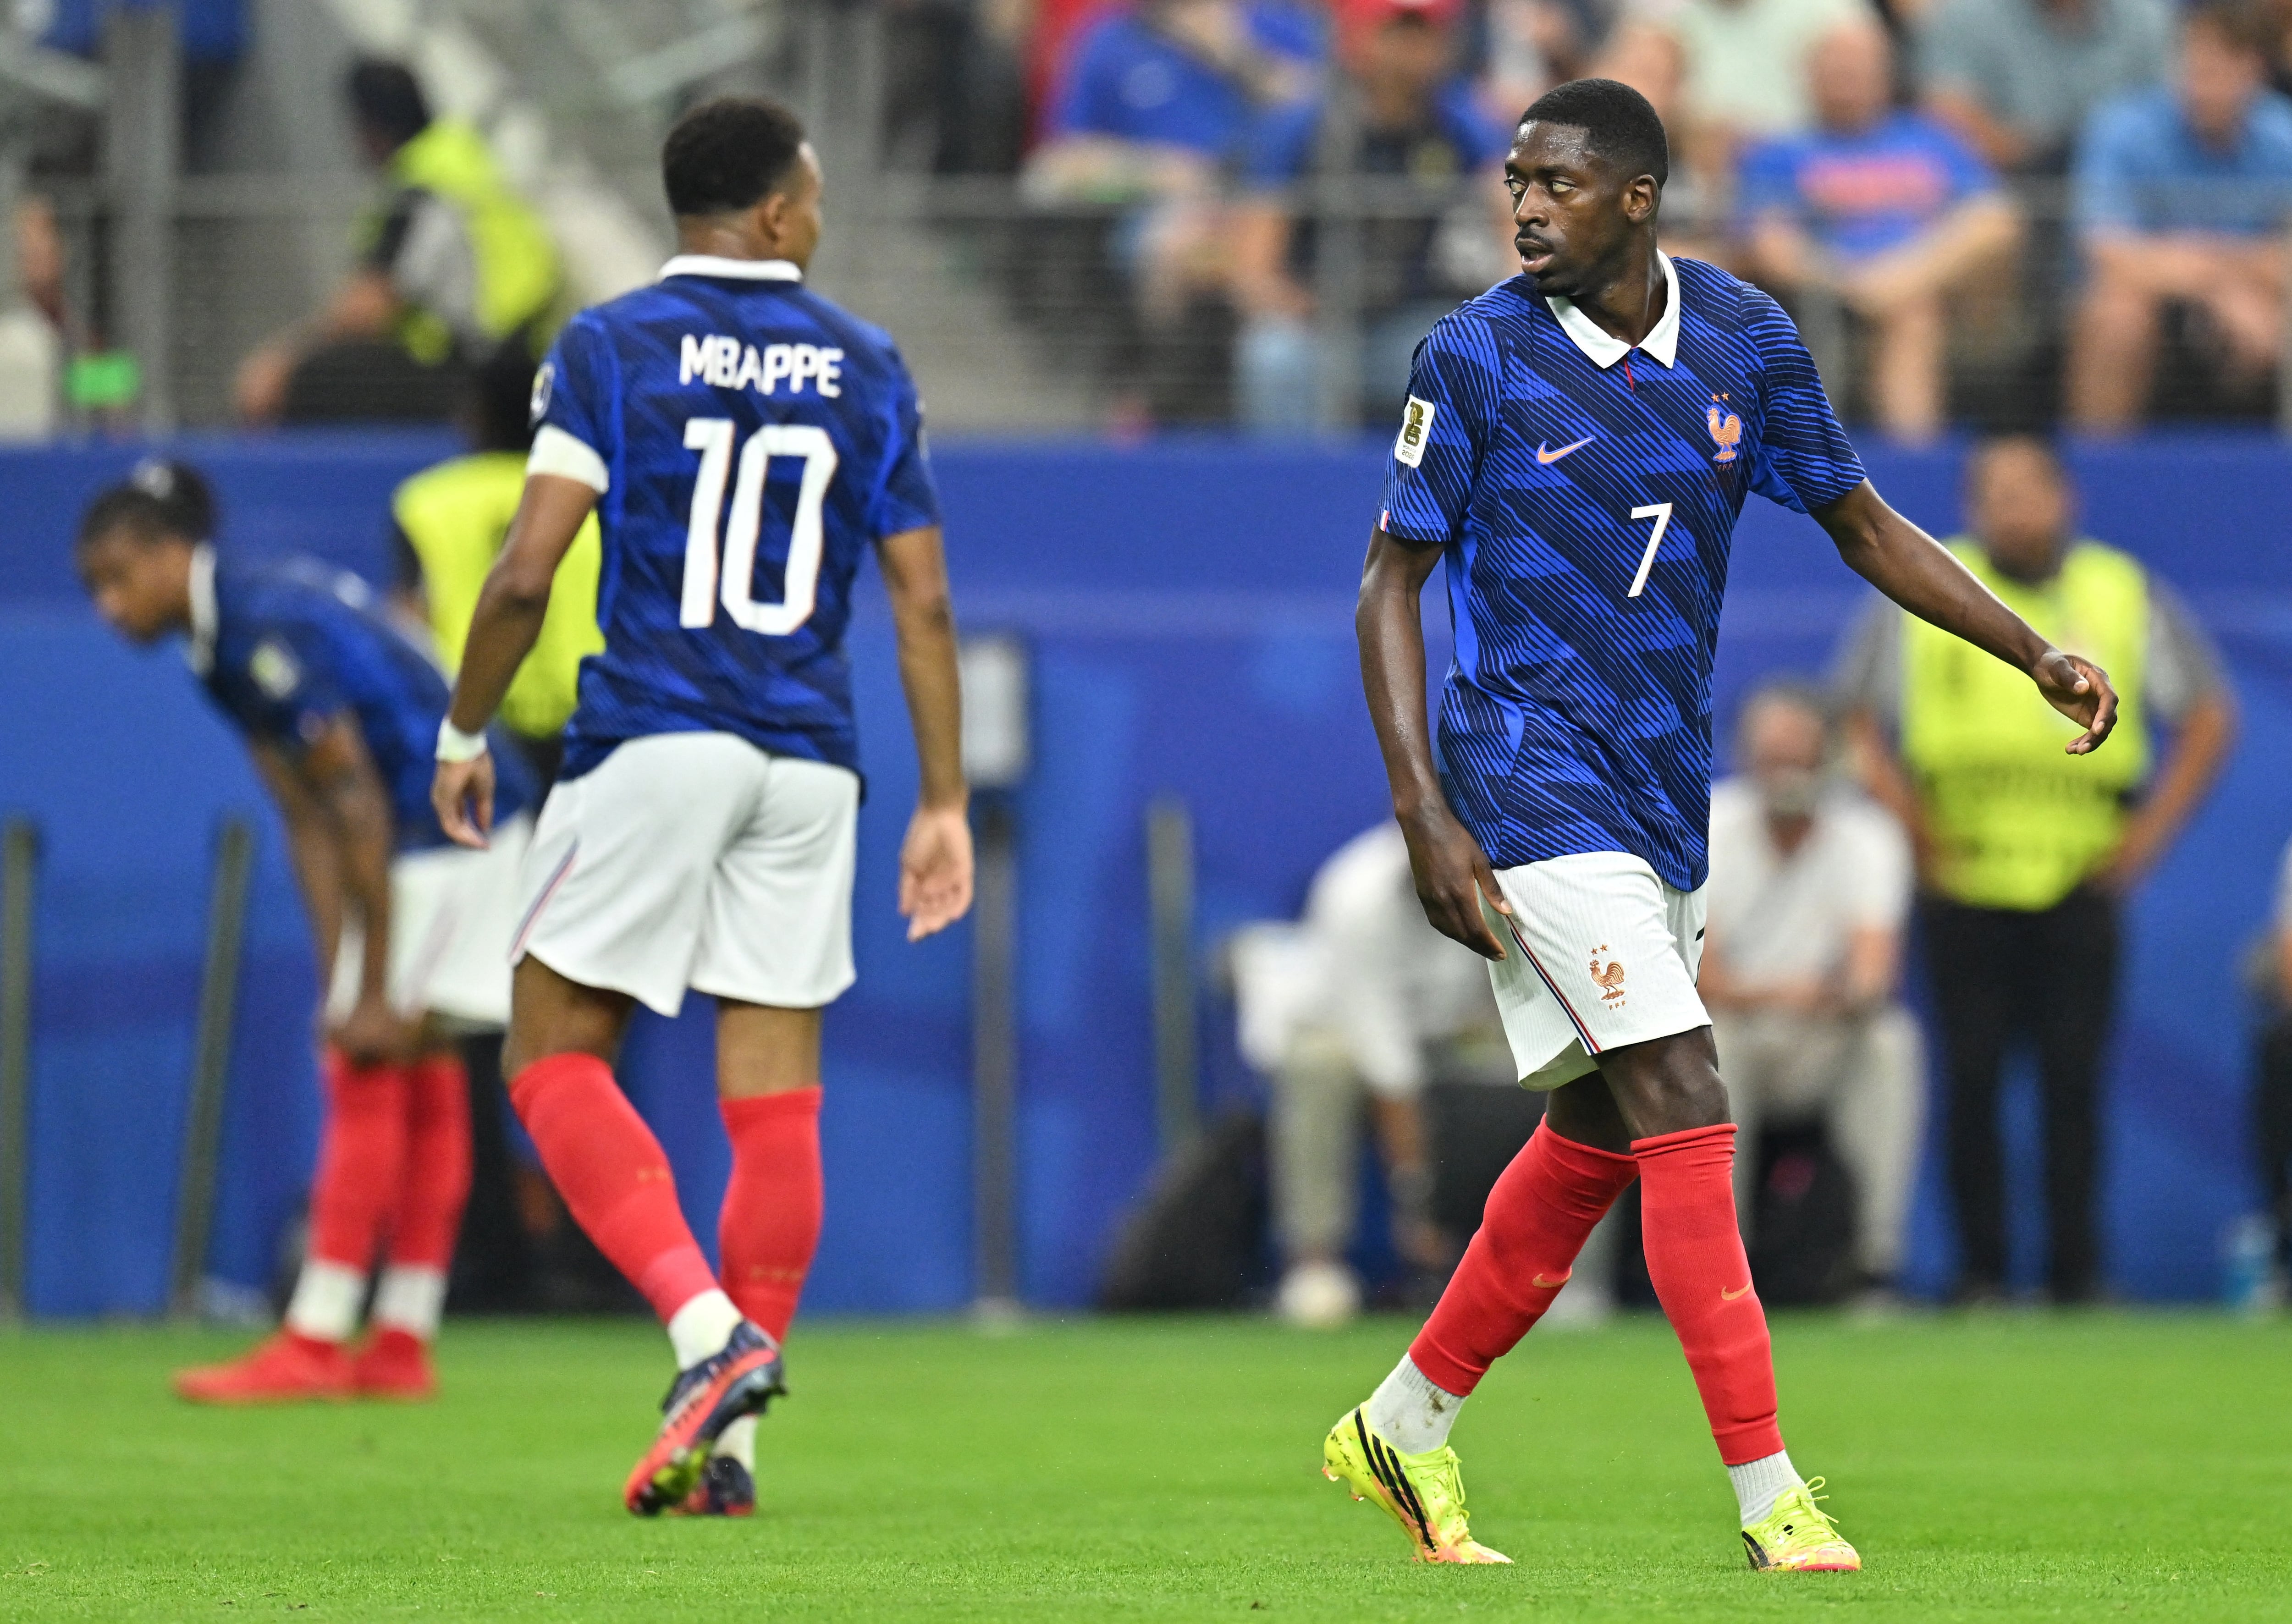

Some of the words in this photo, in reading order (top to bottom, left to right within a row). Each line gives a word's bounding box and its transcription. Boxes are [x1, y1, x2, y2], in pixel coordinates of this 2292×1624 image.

[679, 334, 844, 397] MBAPPE
[1402, 449, 1415, 460] 2026
[679, 418, 838, 636] 10
[1627, 502, 1673, 598] 7
